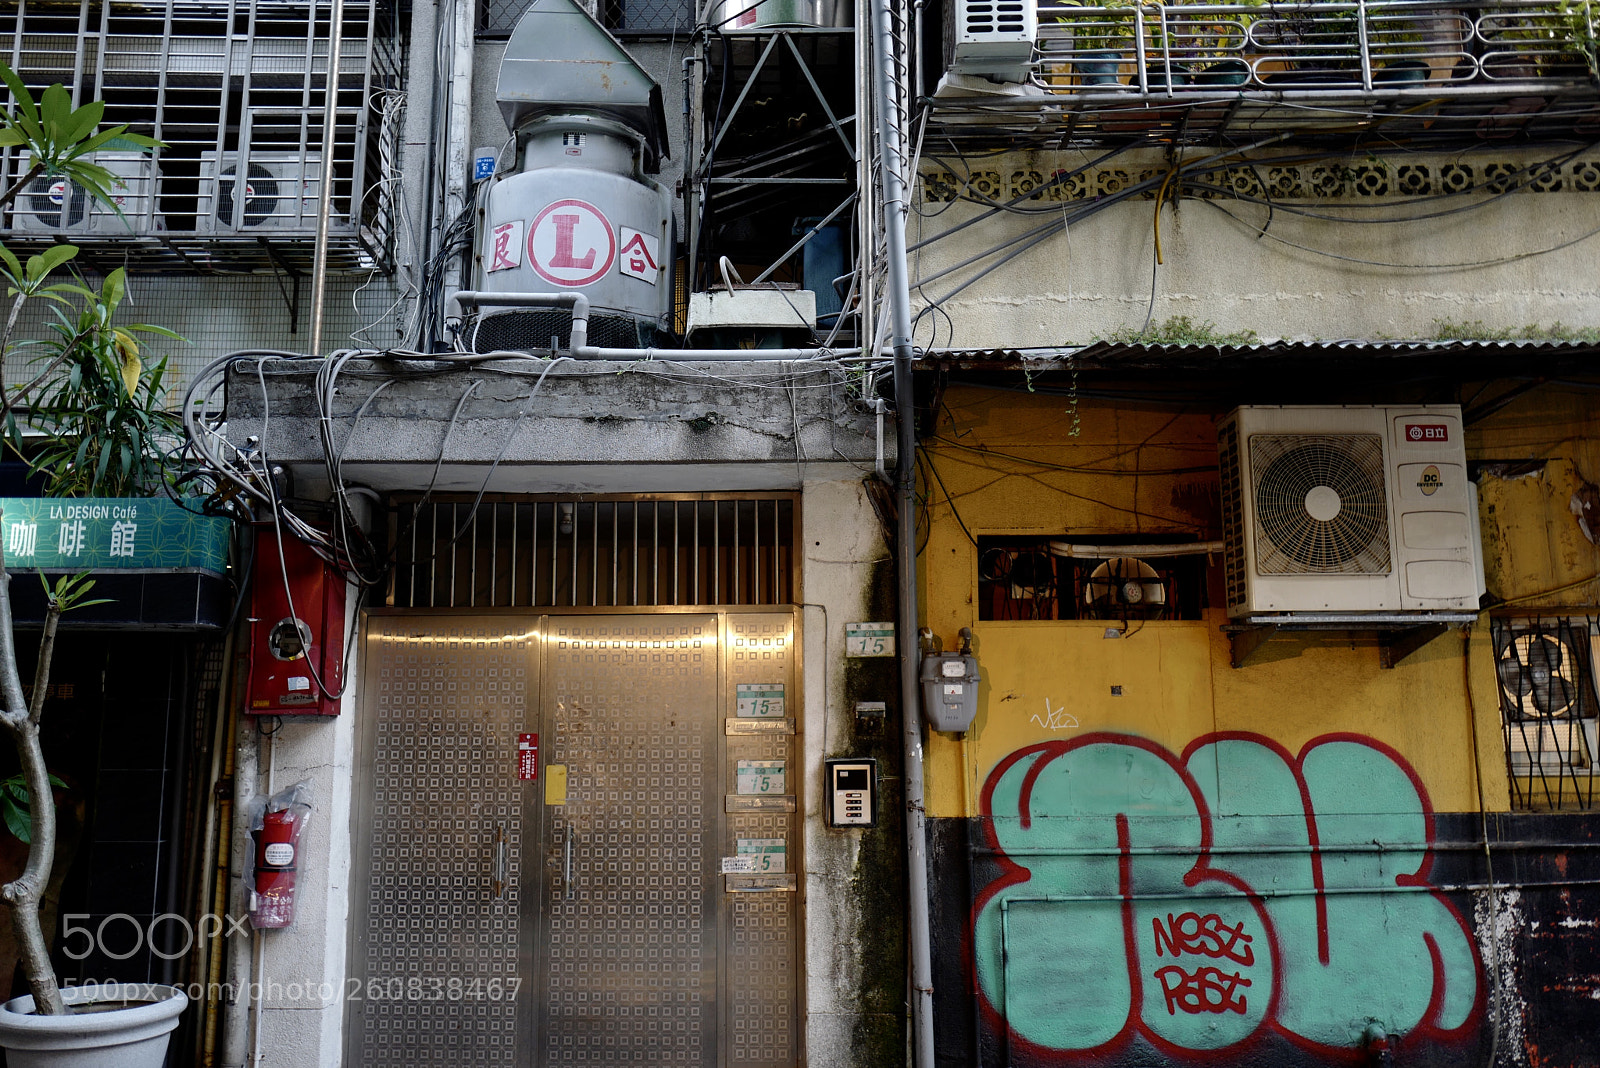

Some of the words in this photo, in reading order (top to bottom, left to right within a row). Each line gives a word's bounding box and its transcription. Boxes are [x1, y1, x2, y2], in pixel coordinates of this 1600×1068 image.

[490, 223, 518, 271] 良
[548, 214, 597, 270] L
[621, 233, 658, 274] 合
[1425, 428, 1445, 438] 日立
[1424, 474, 1438, 482] DC
[66, 505, 109, 519] DESIGN
[112, 505, 137, 519] Café
[9, 519, 137, 557] 咖啡館
[859, 638, 885, 654] 15
[750, 699, 770, 715] 15
[750, 776, 771, 792] 15
